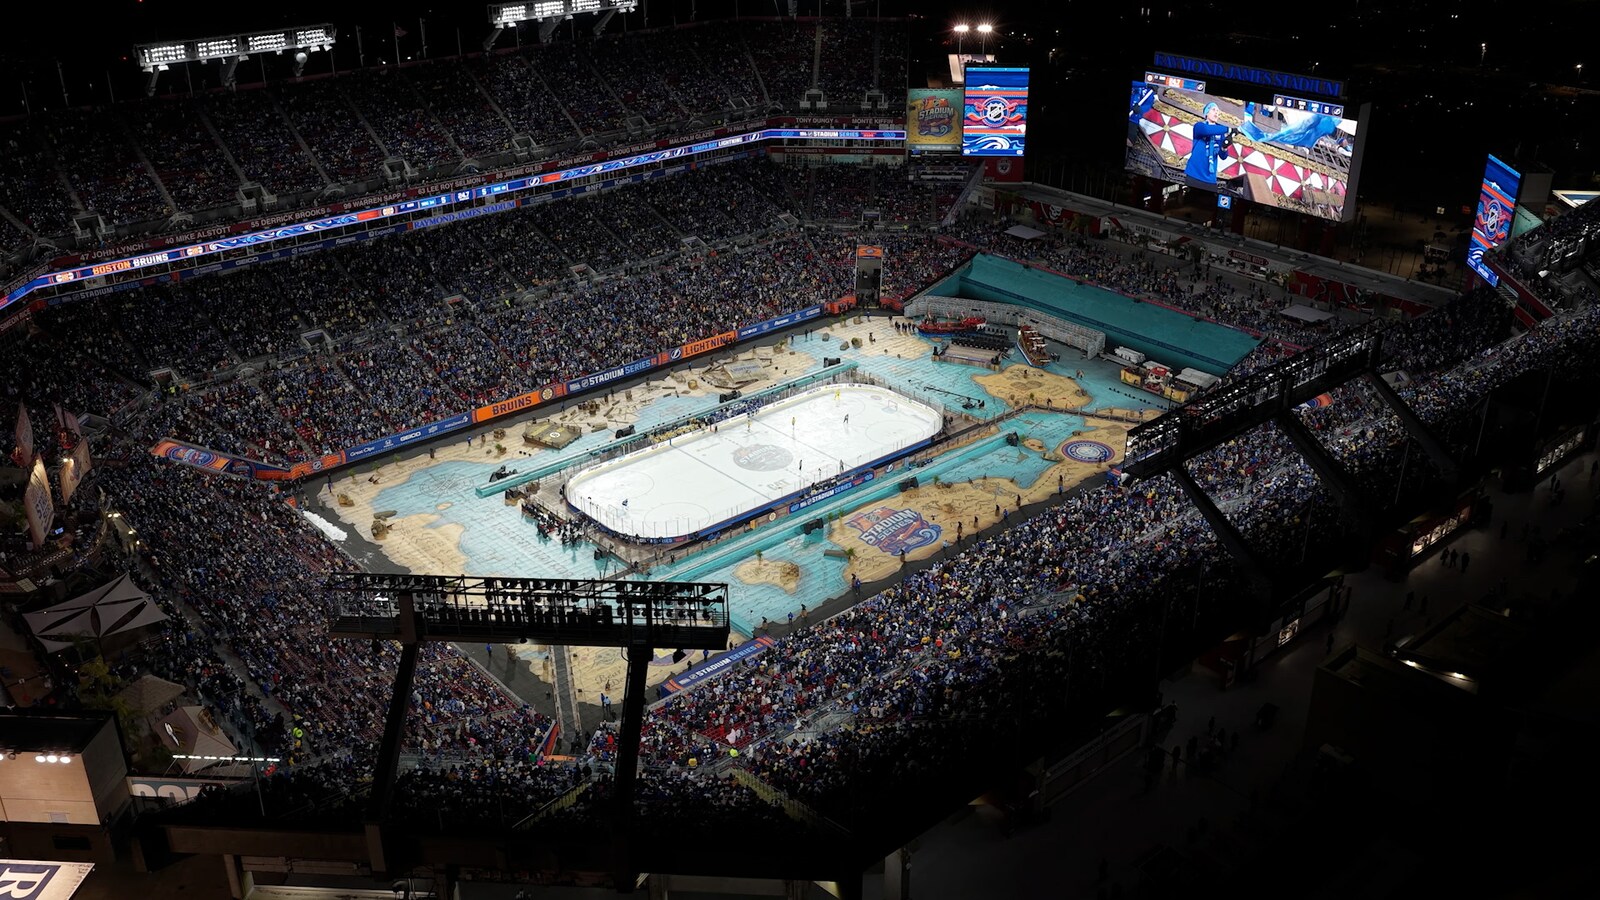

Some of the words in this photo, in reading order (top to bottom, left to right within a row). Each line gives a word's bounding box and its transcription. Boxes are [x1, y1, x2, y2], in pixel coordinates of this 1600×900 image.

[1154, 54, 1224, 76] RAYMOND
[1225, 66, 1272, 86] JAMES
[1274, 72, 1341, 97] STADIUM
[918, 107, 954, 120] STADIUM
[630, 142, 656, 152] WILLIAMS
[669, 135, 694, 144] MALCOLM
[525, 164, 543, 173] GILES
[558, 159, 572, 167] JOHN
[428, 184, 440, 192] LEE
[440, 182, 454, 190] ROY
[454, 177, 481, 188] SELMON
[354, 196, 382, 208] WARREN
[383, 192, 402, 202] SAPP
[250, 220, 260, 228] 55
[261, 214, 294, 226] DERRICK
[294, 208, 326, 220] BROOKS
[414, 215, 454, 229] RAYMOND
[458, 209, 482, 220] JAMES
[482, 202, 515, 214] STADIUM
[165, 236, 174, 245] 40
[176, 232, 196, 243] MIKE
[196, 226, 232, 240] ALSTOTT
[92, 248, 114, 260] JOHN
[116, 243, 144, 254] LYNCH
[92, 261, 131, 276] BOSTON
[132, 253, 168, 268] BRUINS
[80, 287, 114, 300] STADIUM
[685, 334, 732, 356] LIGHTNING
[589, 368, 625, 386] STADIUM
[625, 360, 650, 374] SERIES
[492, 396, 532, 416] BRUINS
[400, 431, 422, 442] GEICO
[812, 490, 834, 502] STADIUM
[834, 482, 852, 494] SERIES
[860, 509, 918, 544] STADIUM
[877, 518, 914, 542] SERIES
[696, 658, 732, 677] STADIUM
[730, 646, 757, 661] SERIES
